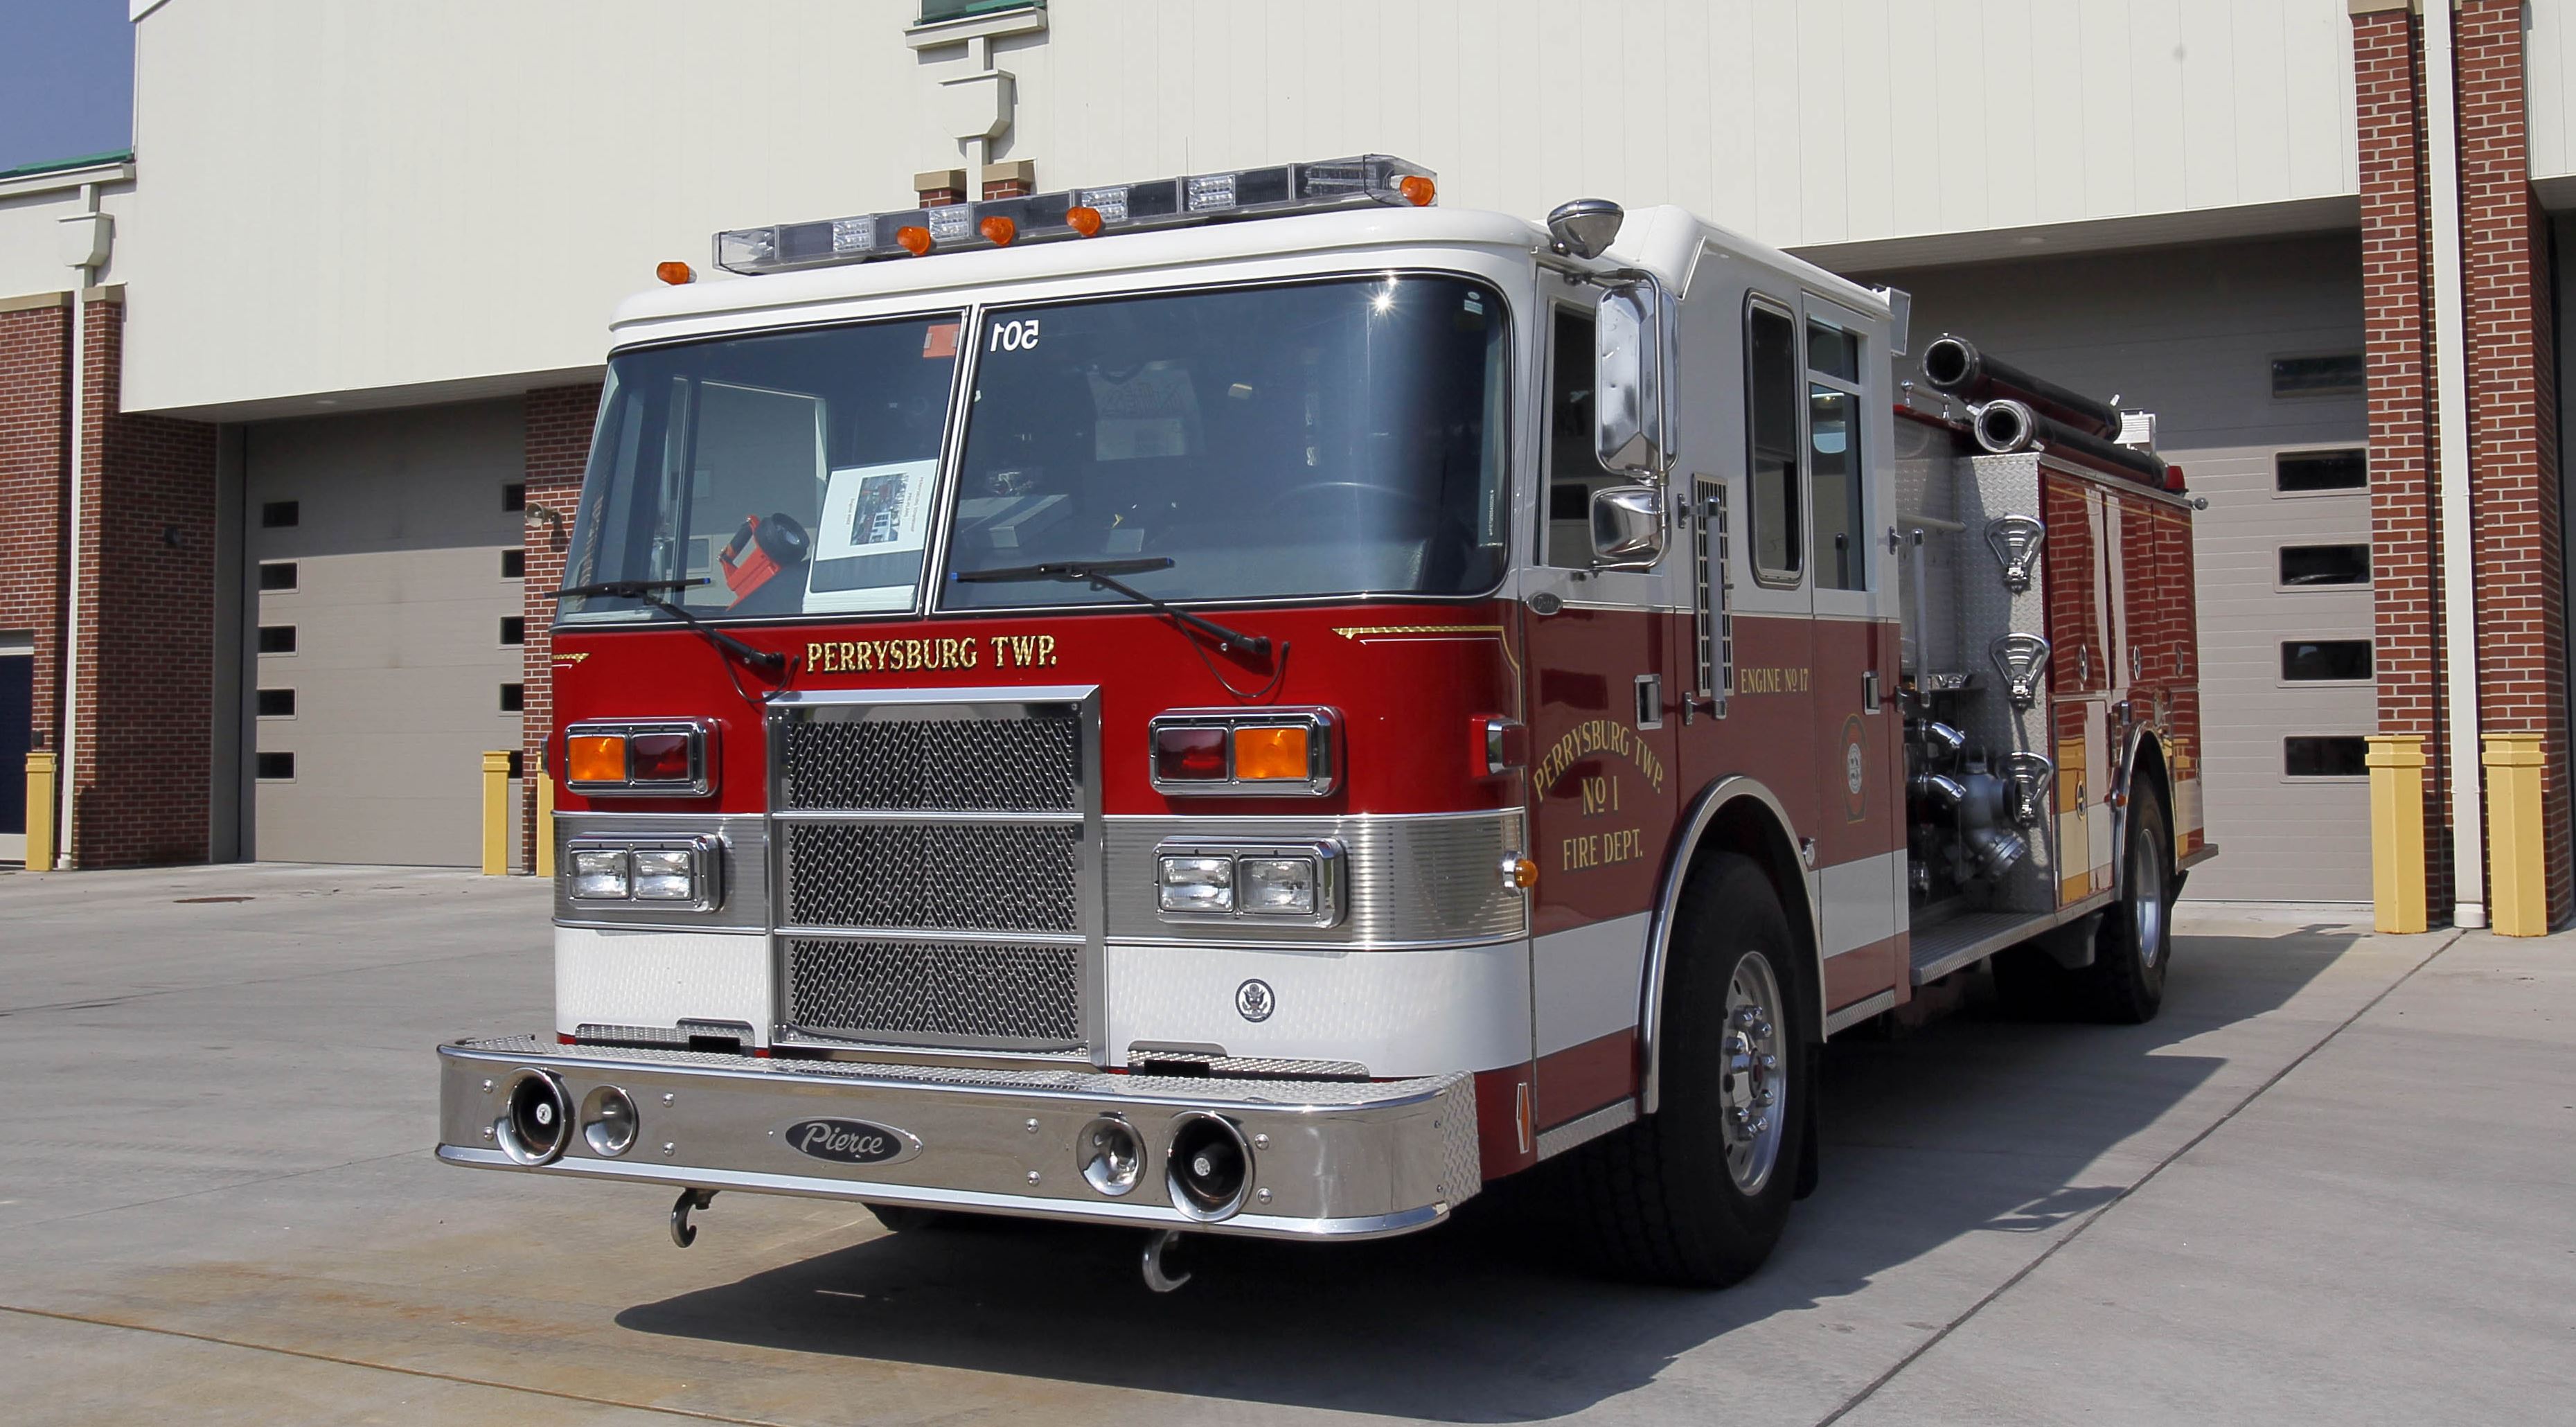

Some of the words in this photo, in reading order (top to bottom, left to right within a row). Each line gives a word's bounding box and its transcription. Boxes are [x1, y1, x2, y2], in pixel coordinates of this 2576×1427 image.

[807, 637, 977, 672] PERRYSBURG
[991, 635, 1057, 667] TWP.
[1741, 668, 1781, 693] ENGINE
[1533, 720, 1630, 803] PERRYSBURG
[1635, 736, 1663, 794] TWP.
[1563, 835, 1598, 871] FIRE
[1604, 828, 1643, 863] DEPT.
[801, 1122, 885, 1155] Pierce
